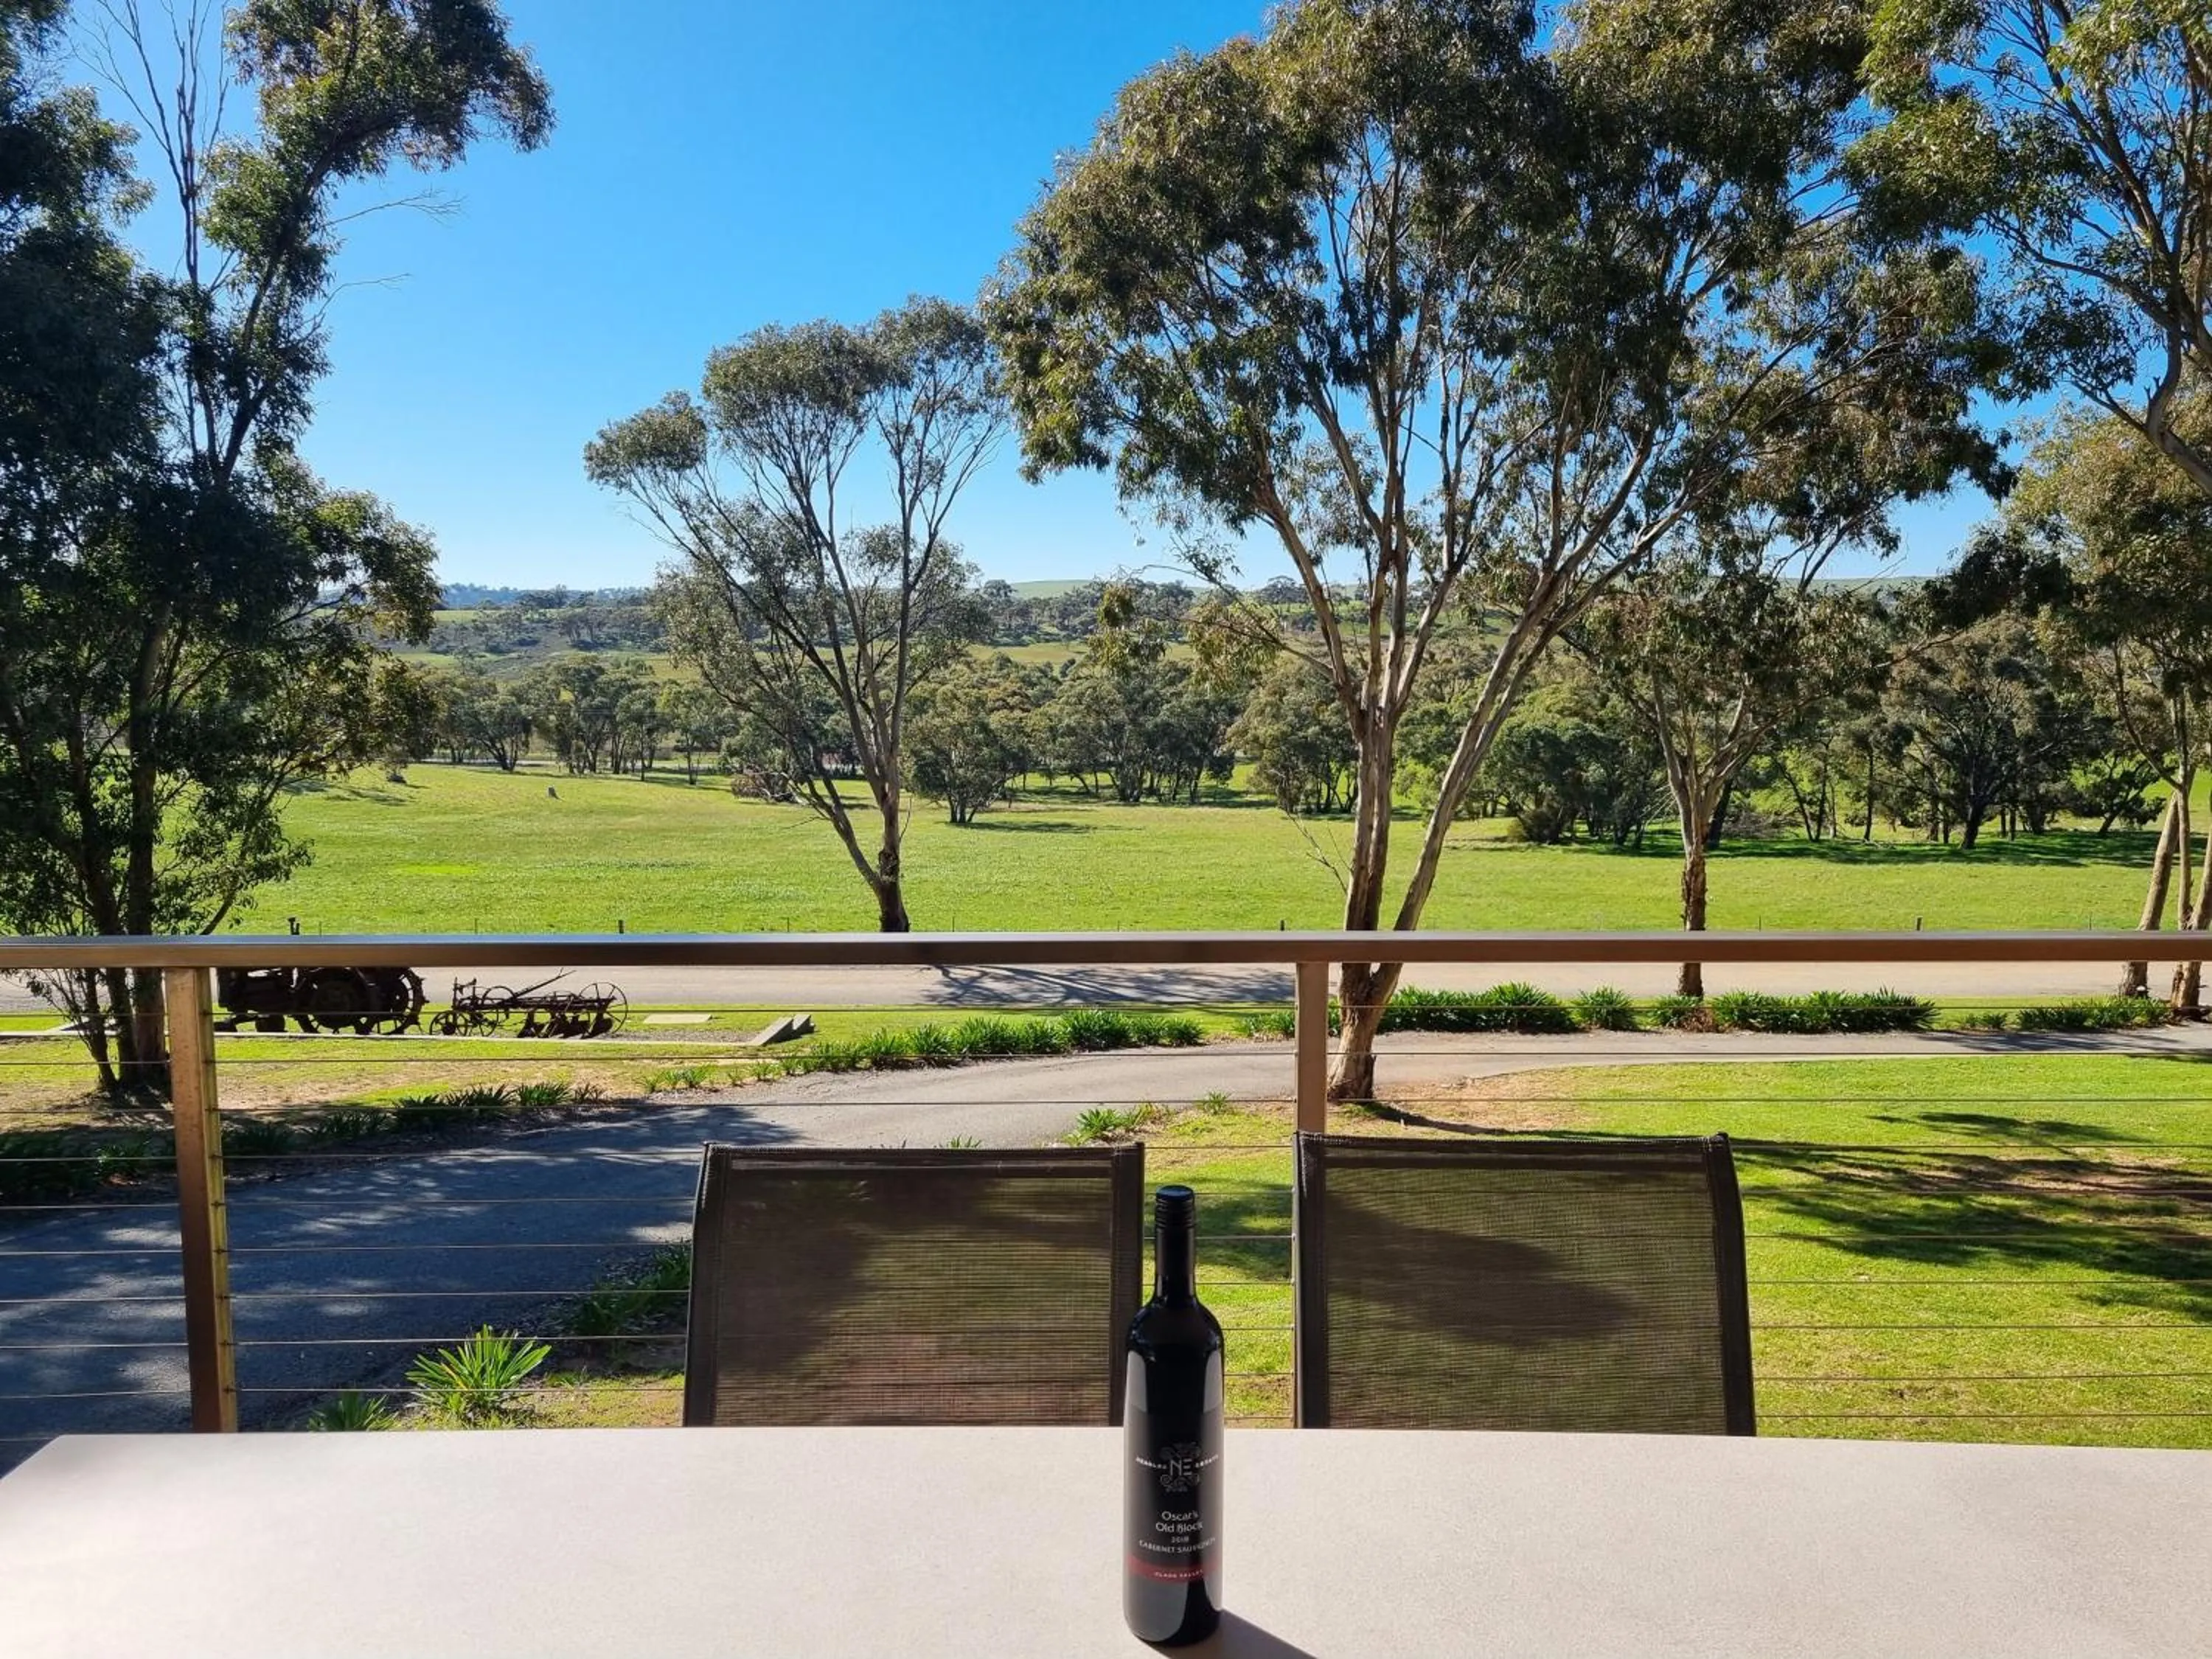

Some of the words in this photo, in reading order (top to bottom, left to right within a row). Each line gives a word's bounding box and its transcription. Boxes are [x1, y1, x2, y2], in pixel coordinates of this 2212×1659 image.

[1161, 1510, 1199, 1521] Oscar's
[1155, 1522, 1175, 1533] Old
[1176, 1521, 1203, 1533] Block
[1138, 1539, 1175, 1553] CABERNET
